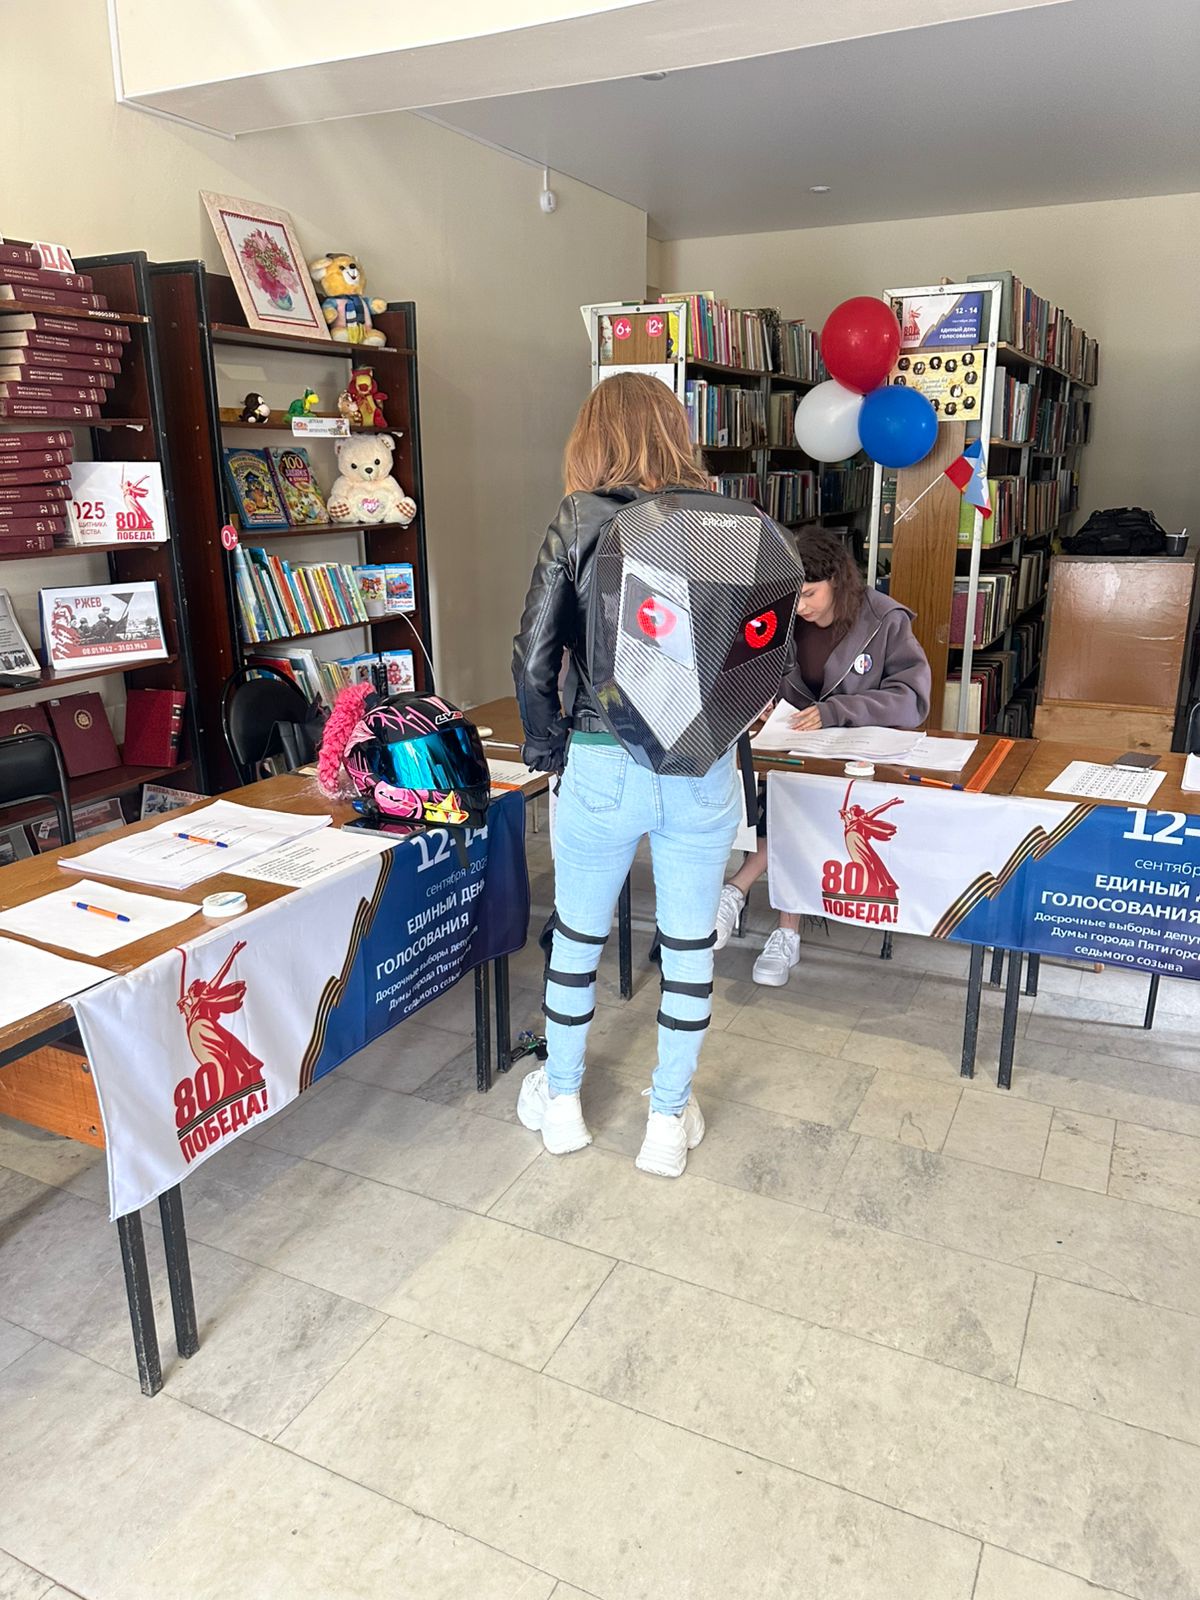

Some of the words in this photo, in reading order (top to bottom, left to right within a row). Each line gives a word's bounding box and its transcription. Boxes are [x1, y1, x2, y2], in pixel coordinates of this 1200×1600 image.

[969, 306, 978, 314] 14
[616, 322, 632, 336] 6+
[648, 319, 664, 334] 12+
[940, 326, 962, 334] ЕДИНЫЙ
[282, 456, 304, 470] 100
[116, 511, 137, 529] 80
[117, 531, 156, 540] ПОБЕДА!
[223, 530, 238, 546] 0+
[75, 596, 102, 609] РЖЕВ
[426, 868, 467, 898] сентября
[822, 860, 865, 895] 80
[1095, 874, 1190, 899] ЕДИНЫЙ
[407, 890, 458, 935] ЕДИНЫЙ
[823, 899, 899, 925] ПОБЕДА!
[1041, 890, 1200, 925] ГОЛОСОВАНИЯ
[1034, 912, 1107, 929] Досрочные
[1108, 920, 1161, 937] выборы
[376, 912, 470, 981] ГОЛОСОВАНИЯ
[1051, 927, 1088, 941] Думы
[1091, 932, 1135, 948] города
[1137, 938, 1200, 961] Пятигорс
[1074, 944, 1135, 963] седьмого
[1136, 955, 1183, 973] созыва
[376, 968, 420, 1004] Досрочные
[389, 989, 412, 1012] Думы
[403, 984, 439, 1014] седьмого
[173, 1061, 222, 1130] 80
[178, 1088, 269, 1165] ПОБЕДА!
